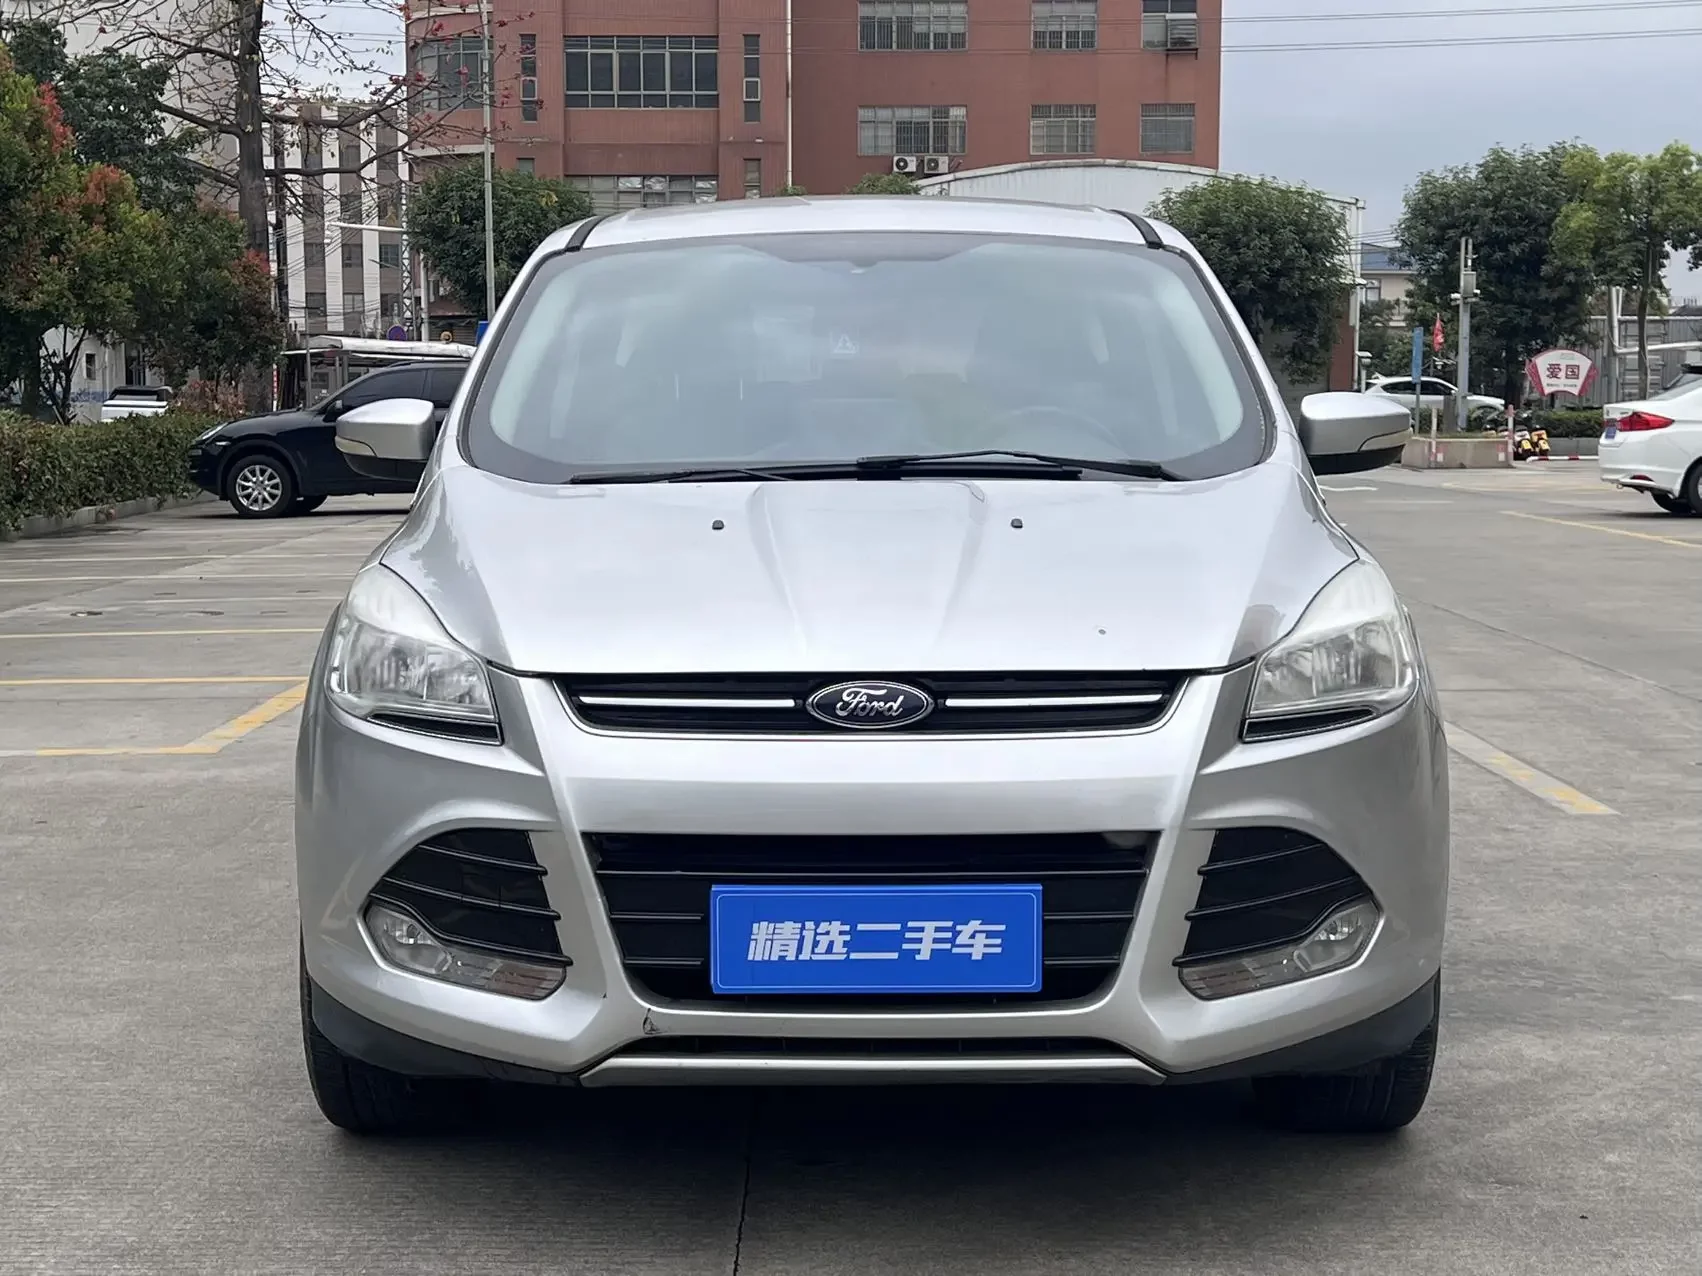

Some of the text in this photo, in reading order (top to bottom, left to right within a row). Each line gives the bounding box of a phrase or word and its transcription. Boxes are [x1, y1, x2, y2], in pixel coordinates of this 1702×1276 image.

[1546, 363, 1580, 380] 爱国
[835, 687, 905, 717] Ford
[747, 920, 1006, 961] 精选二手车
